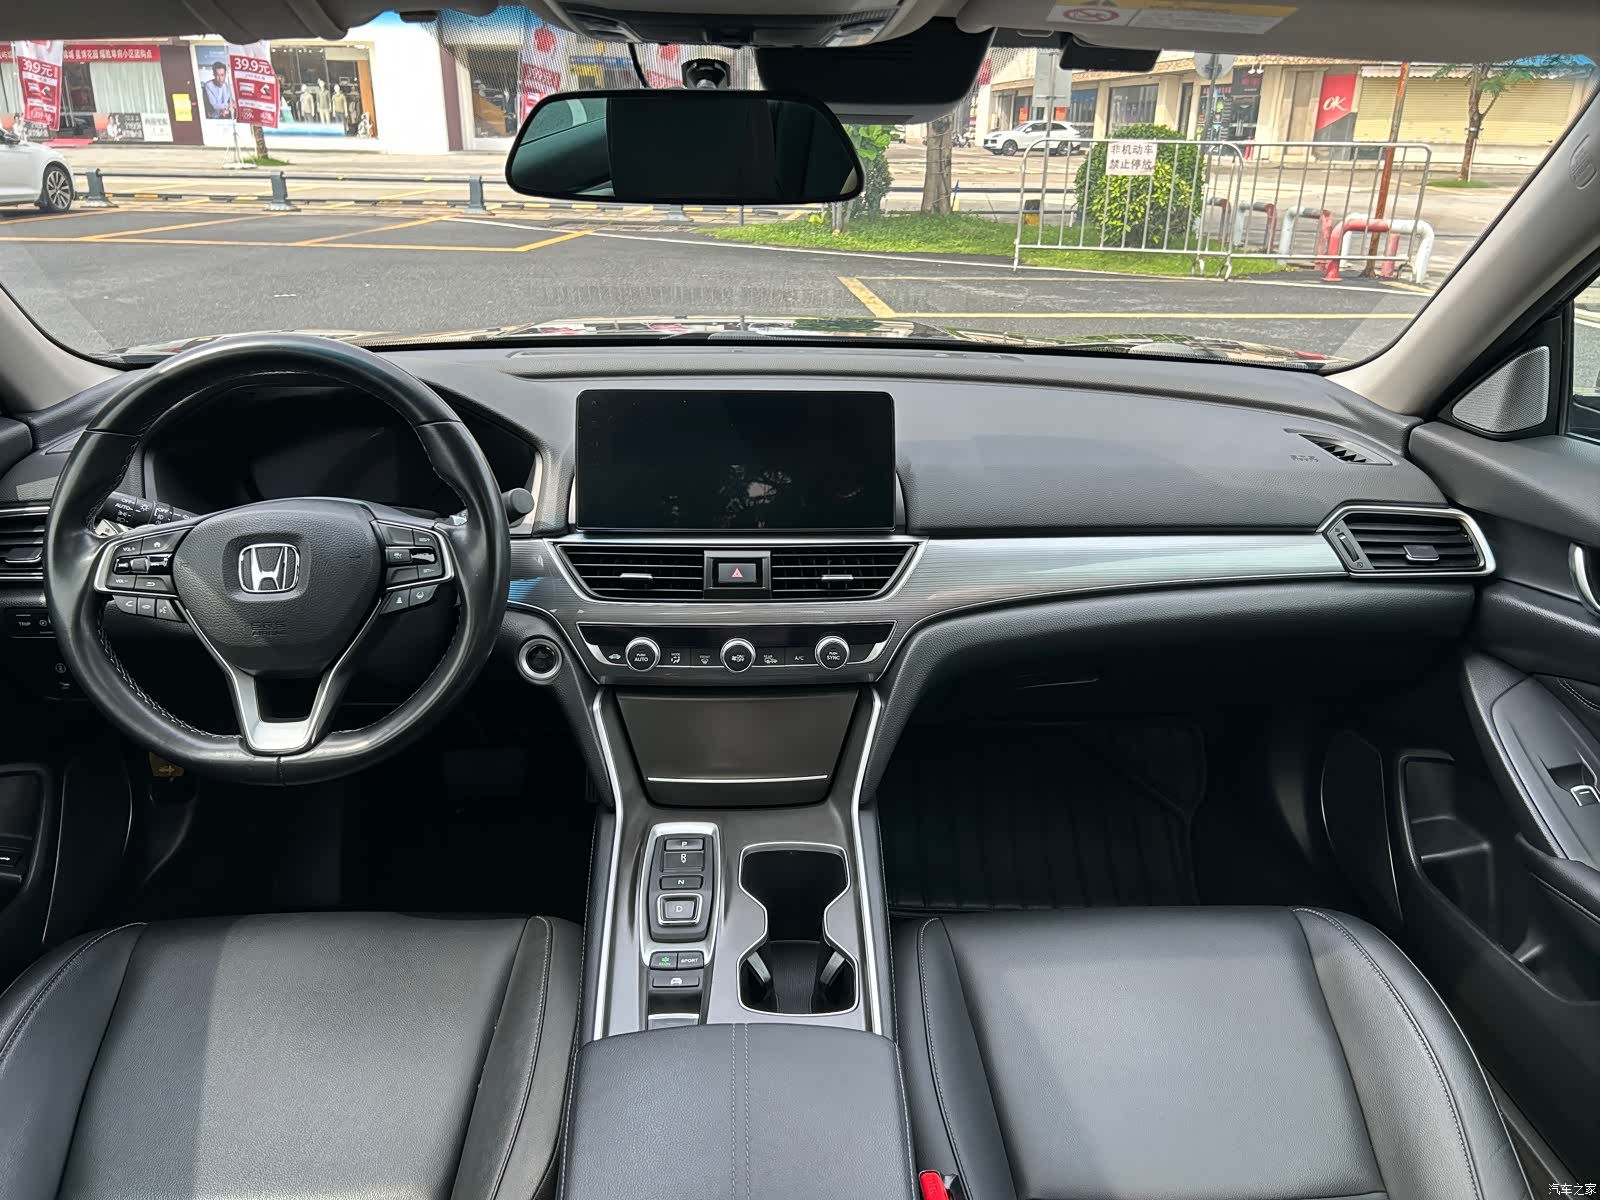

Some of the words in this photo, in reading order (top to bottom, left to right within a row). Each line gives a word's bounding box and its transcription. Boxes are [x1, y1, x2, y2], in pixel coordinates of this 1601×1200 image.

[233, 57, 271, 75] 39.9元
[1322, 95, 1347, 112] OK
[1110, 144, 1154, 156] 非机动车
[1108, 158, 1153, 170] 禁止停放
[115, 502, 131, 511] AUTO
[675, 904, 683, 913] D
